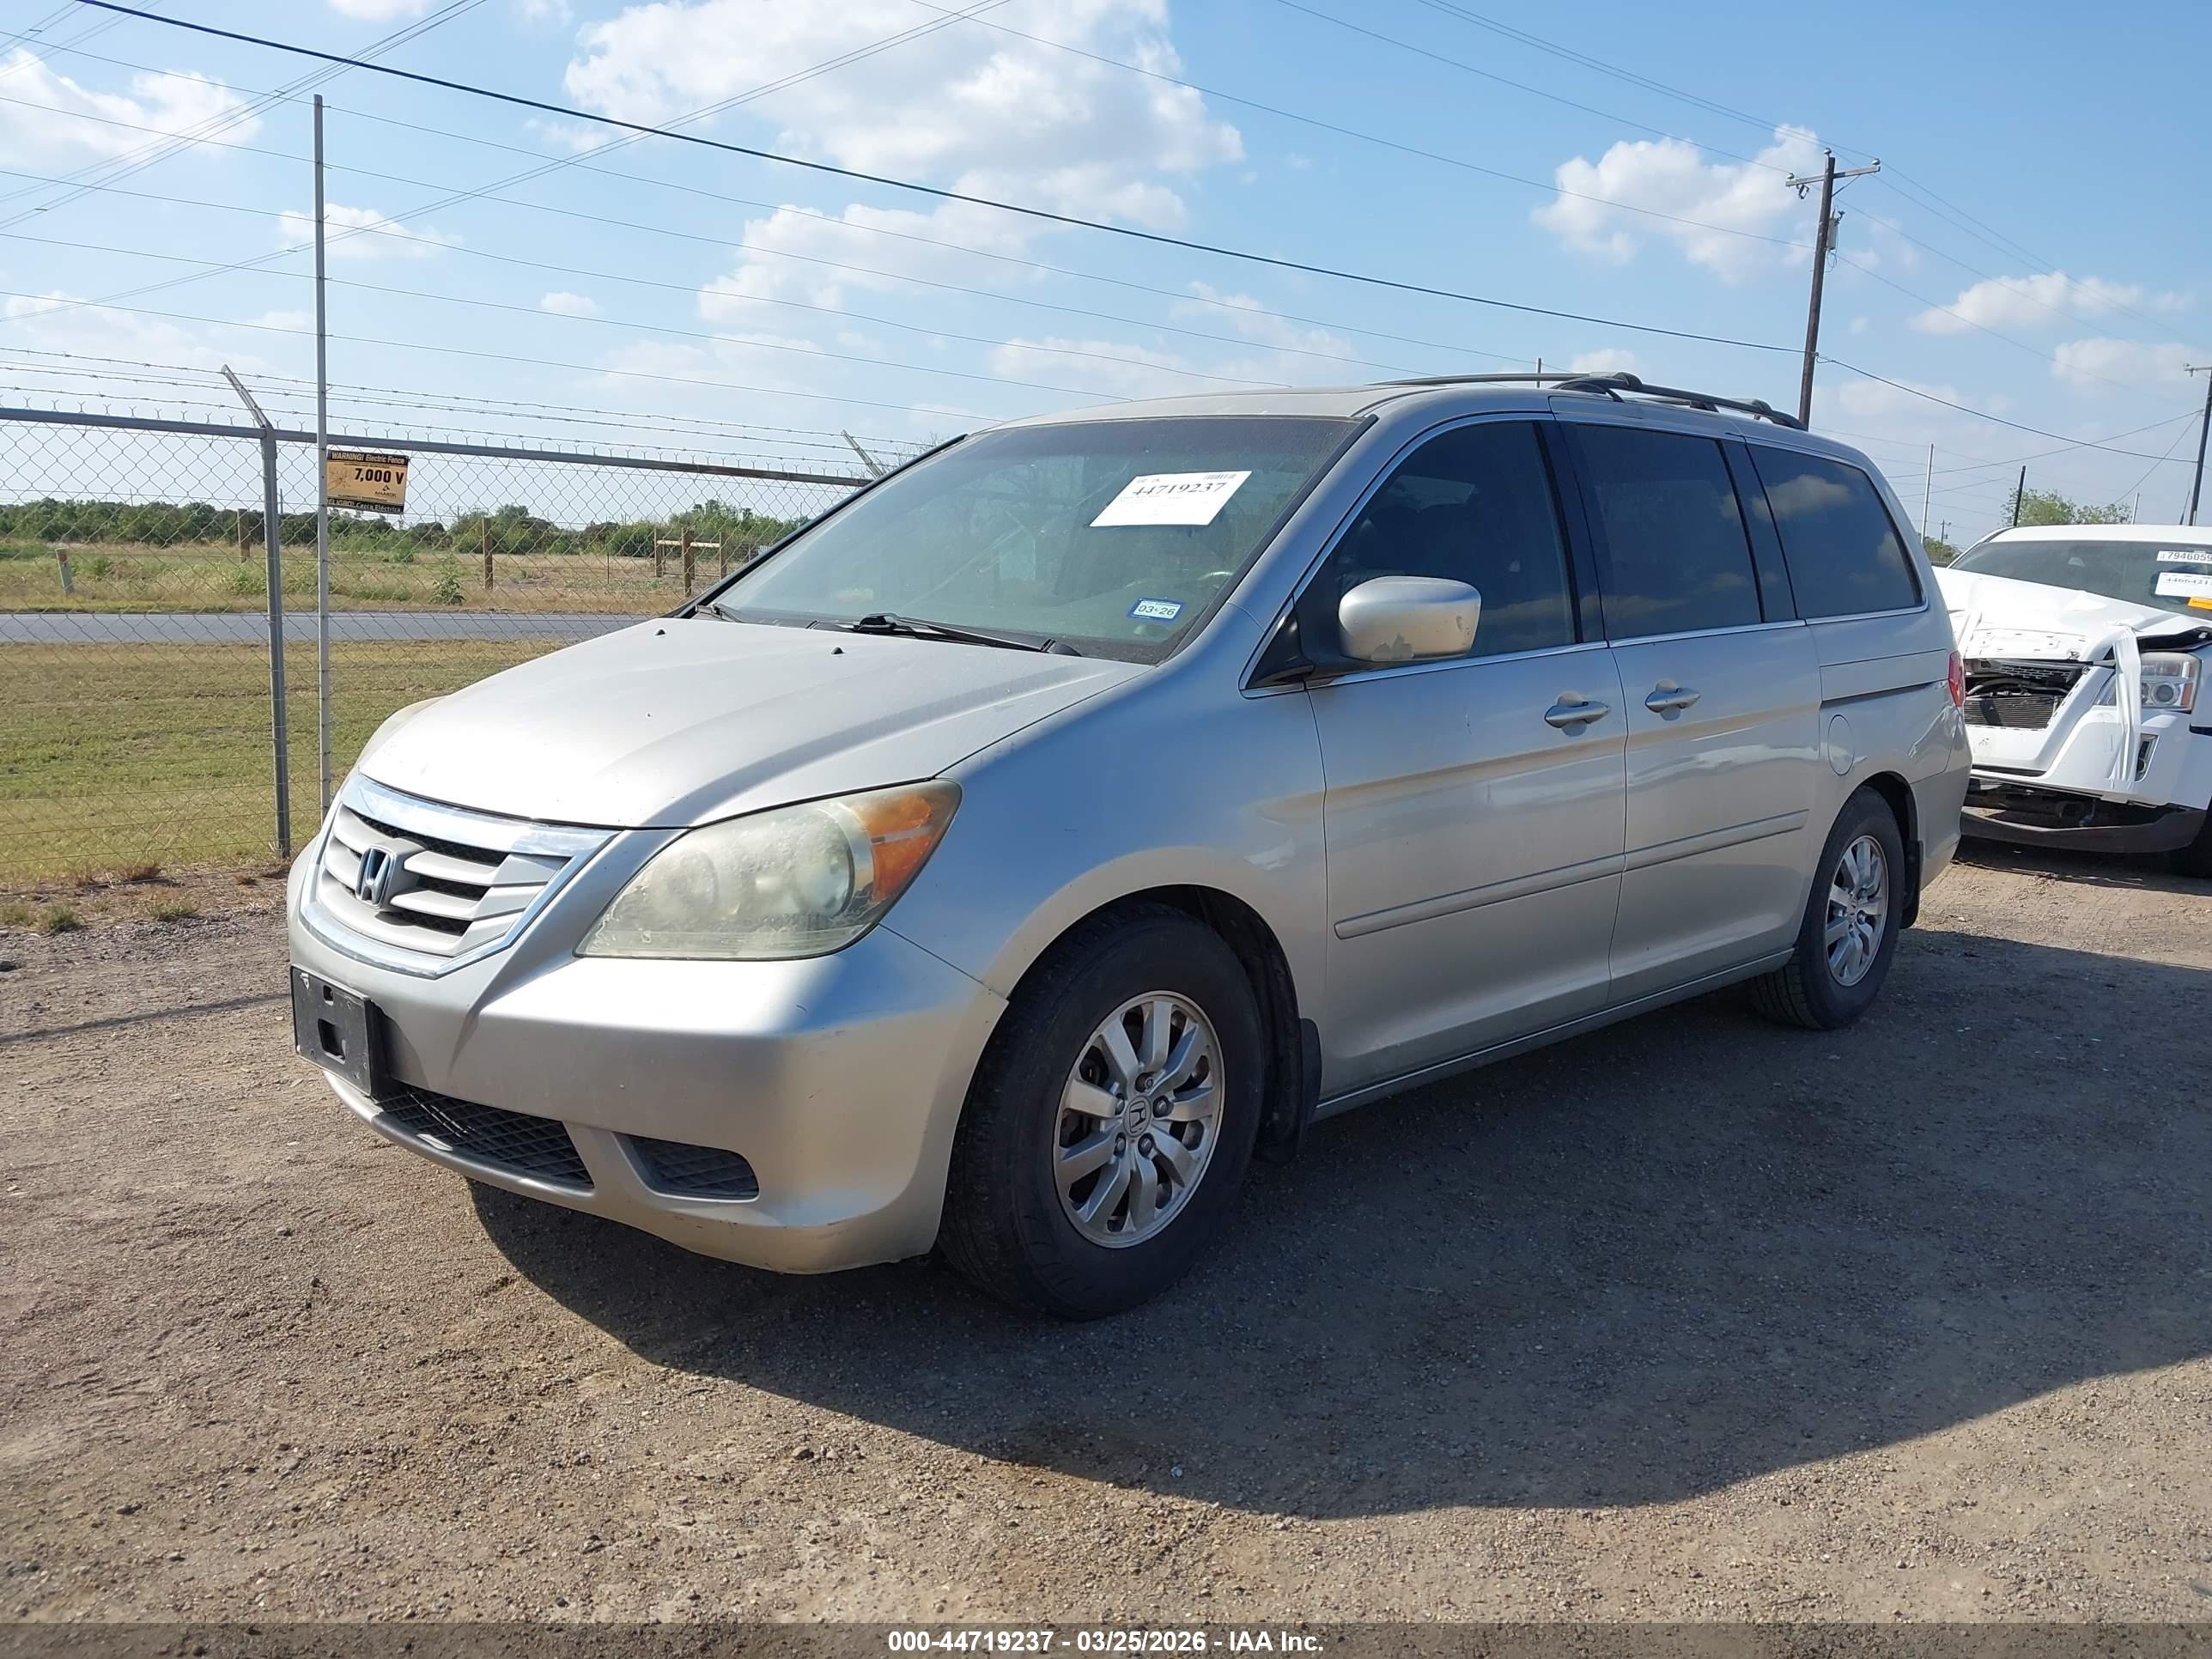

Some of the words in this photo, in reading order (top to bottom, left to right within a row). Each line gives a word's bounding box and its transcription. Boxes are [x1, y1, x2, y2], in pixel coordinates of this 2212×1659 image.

[331, 452, 364, 460] WARNING!
[387, 456, 405, 465] Fence
[355, 468, 392, 483] 7,000
[395, 471, 404, 484] V
[1133, 483, 1227, 495] 44719237
[356, 501, 374, 510] Cerca
[1158, 607, 1176, 616] 26
